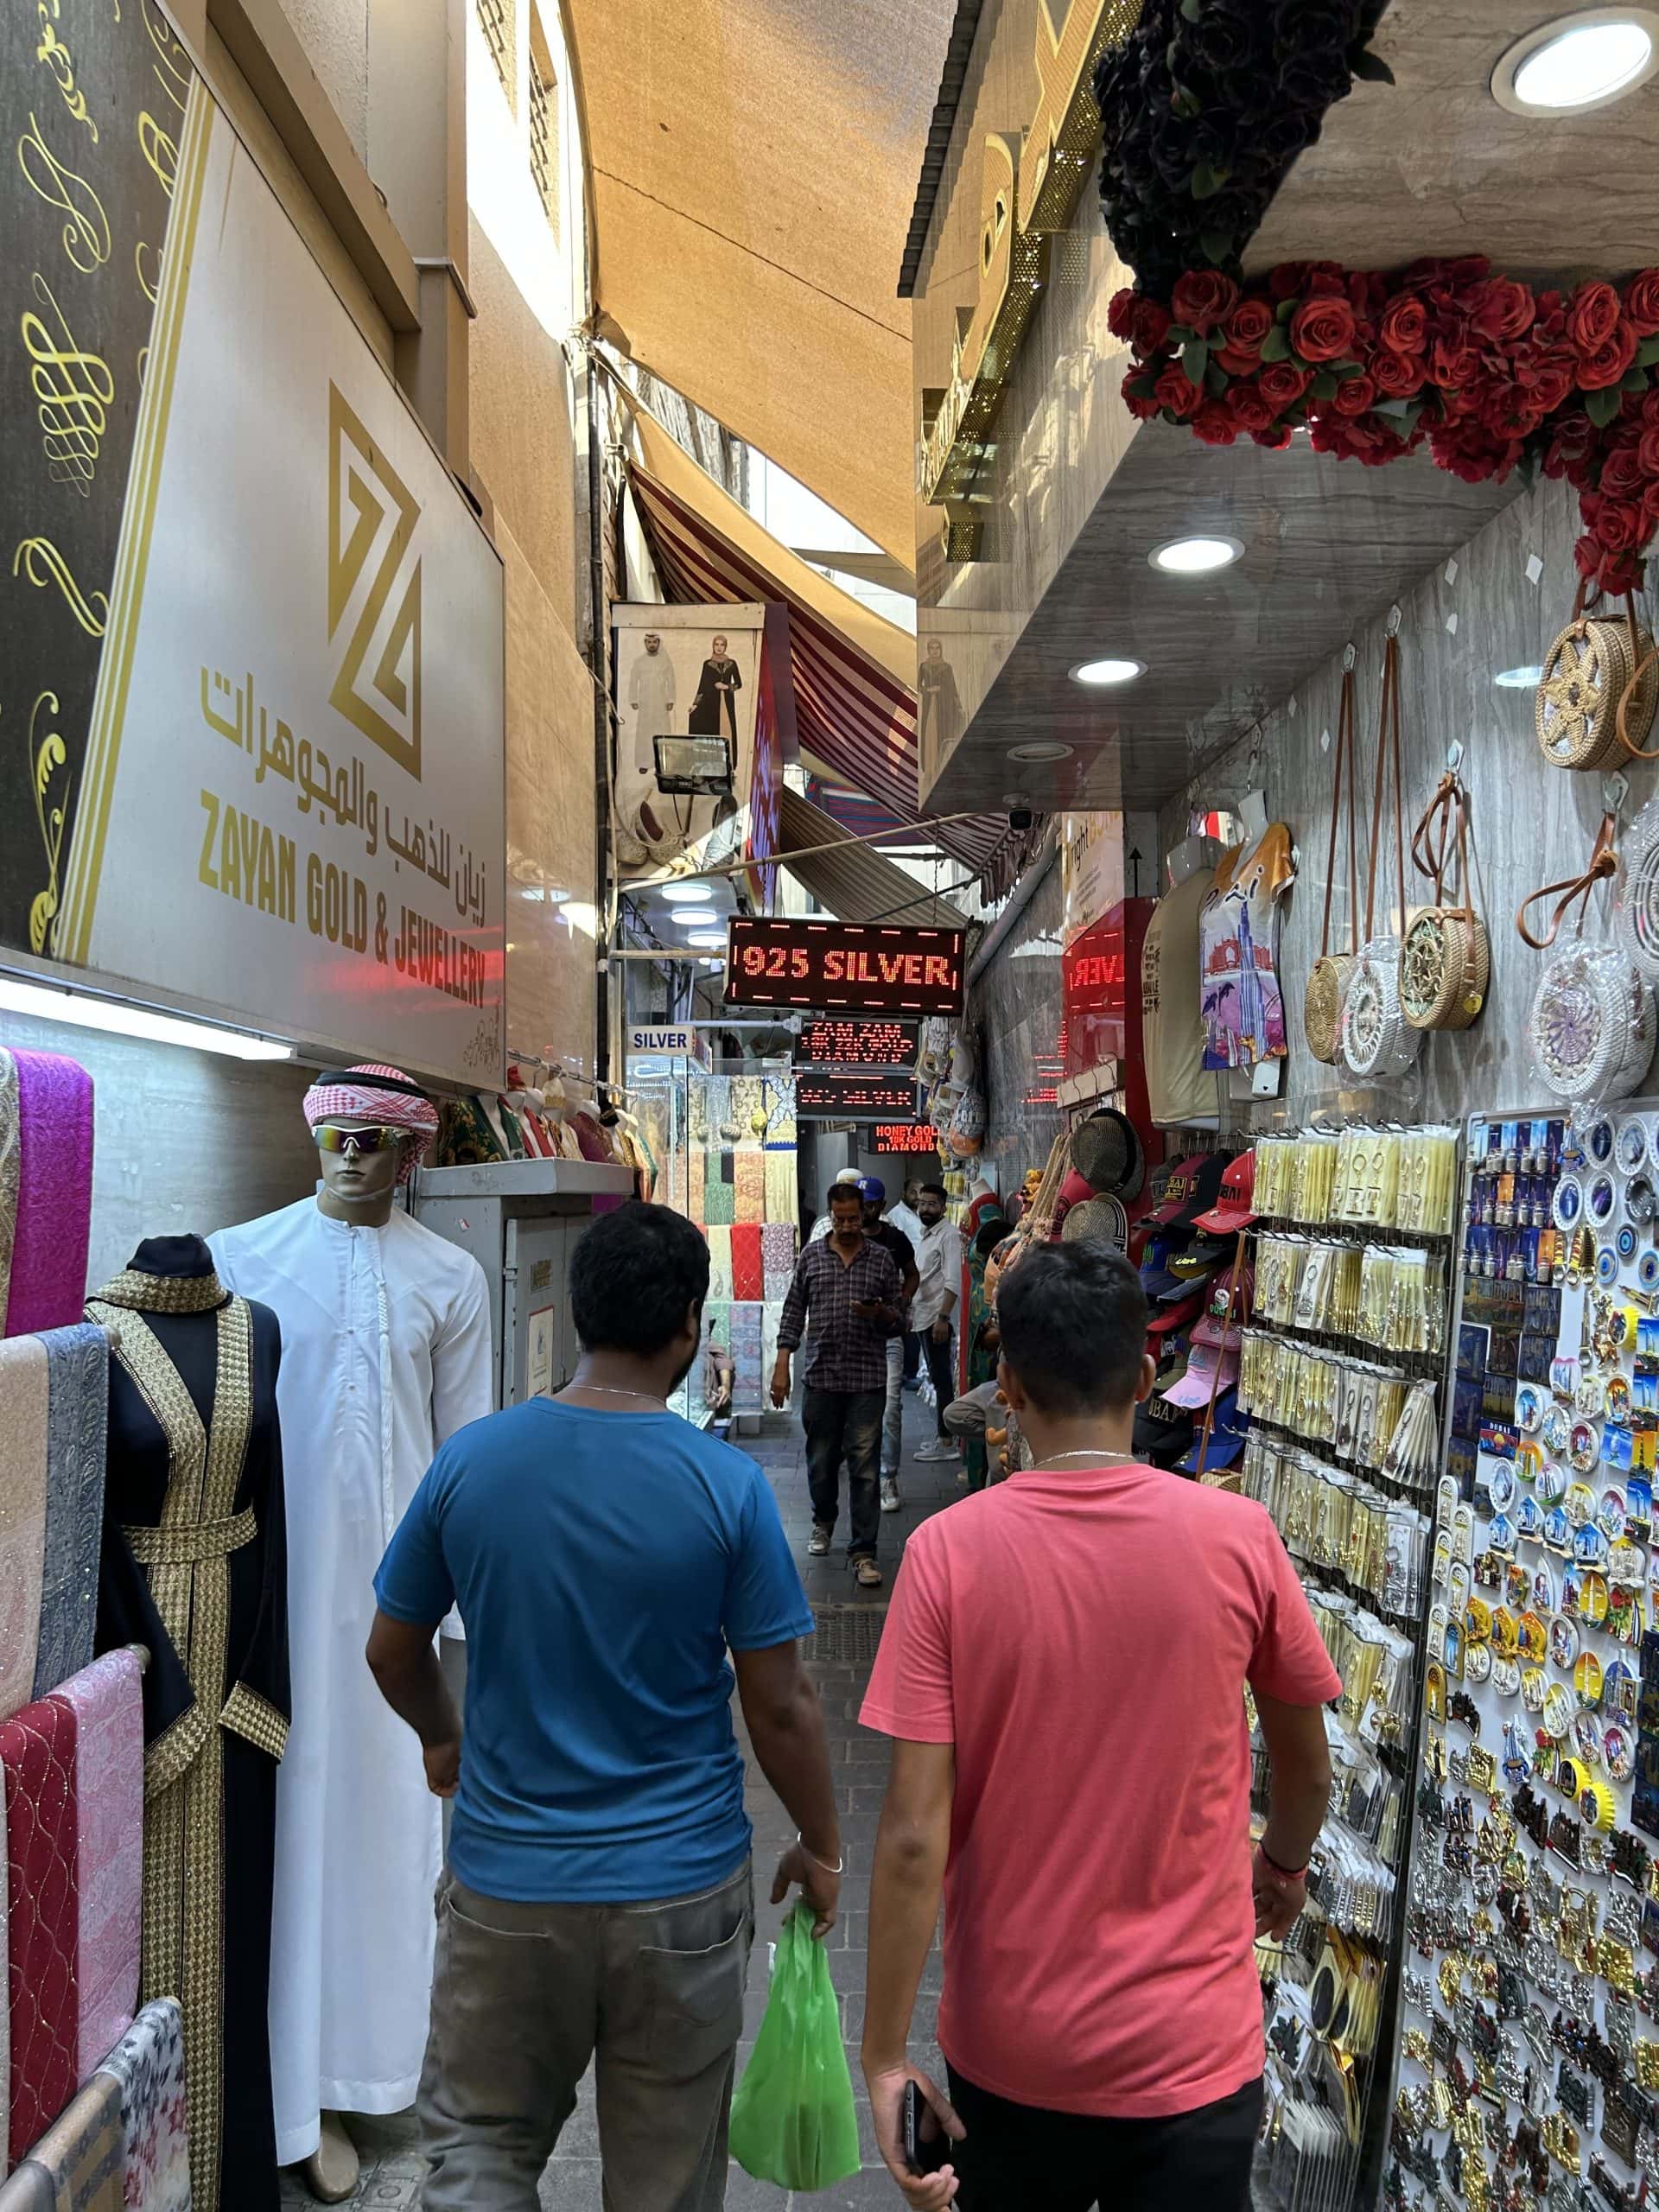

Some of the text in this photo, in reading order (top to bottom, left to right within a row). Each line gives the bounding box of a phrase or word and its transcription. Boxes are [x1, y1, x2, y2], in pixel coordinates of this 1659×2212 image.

[200, 664, 378, 856] والمجوهرات
[385, 805, 450, 890] للذهب
[198, 787, 486, 1009] ZAYAN GOLD & JEWELLERY
[741, 945, 950, 987] 925 SILVER
[633, 1033, 688, 1049] SILVER
[876, 1125, 913, 1137] HONEY
